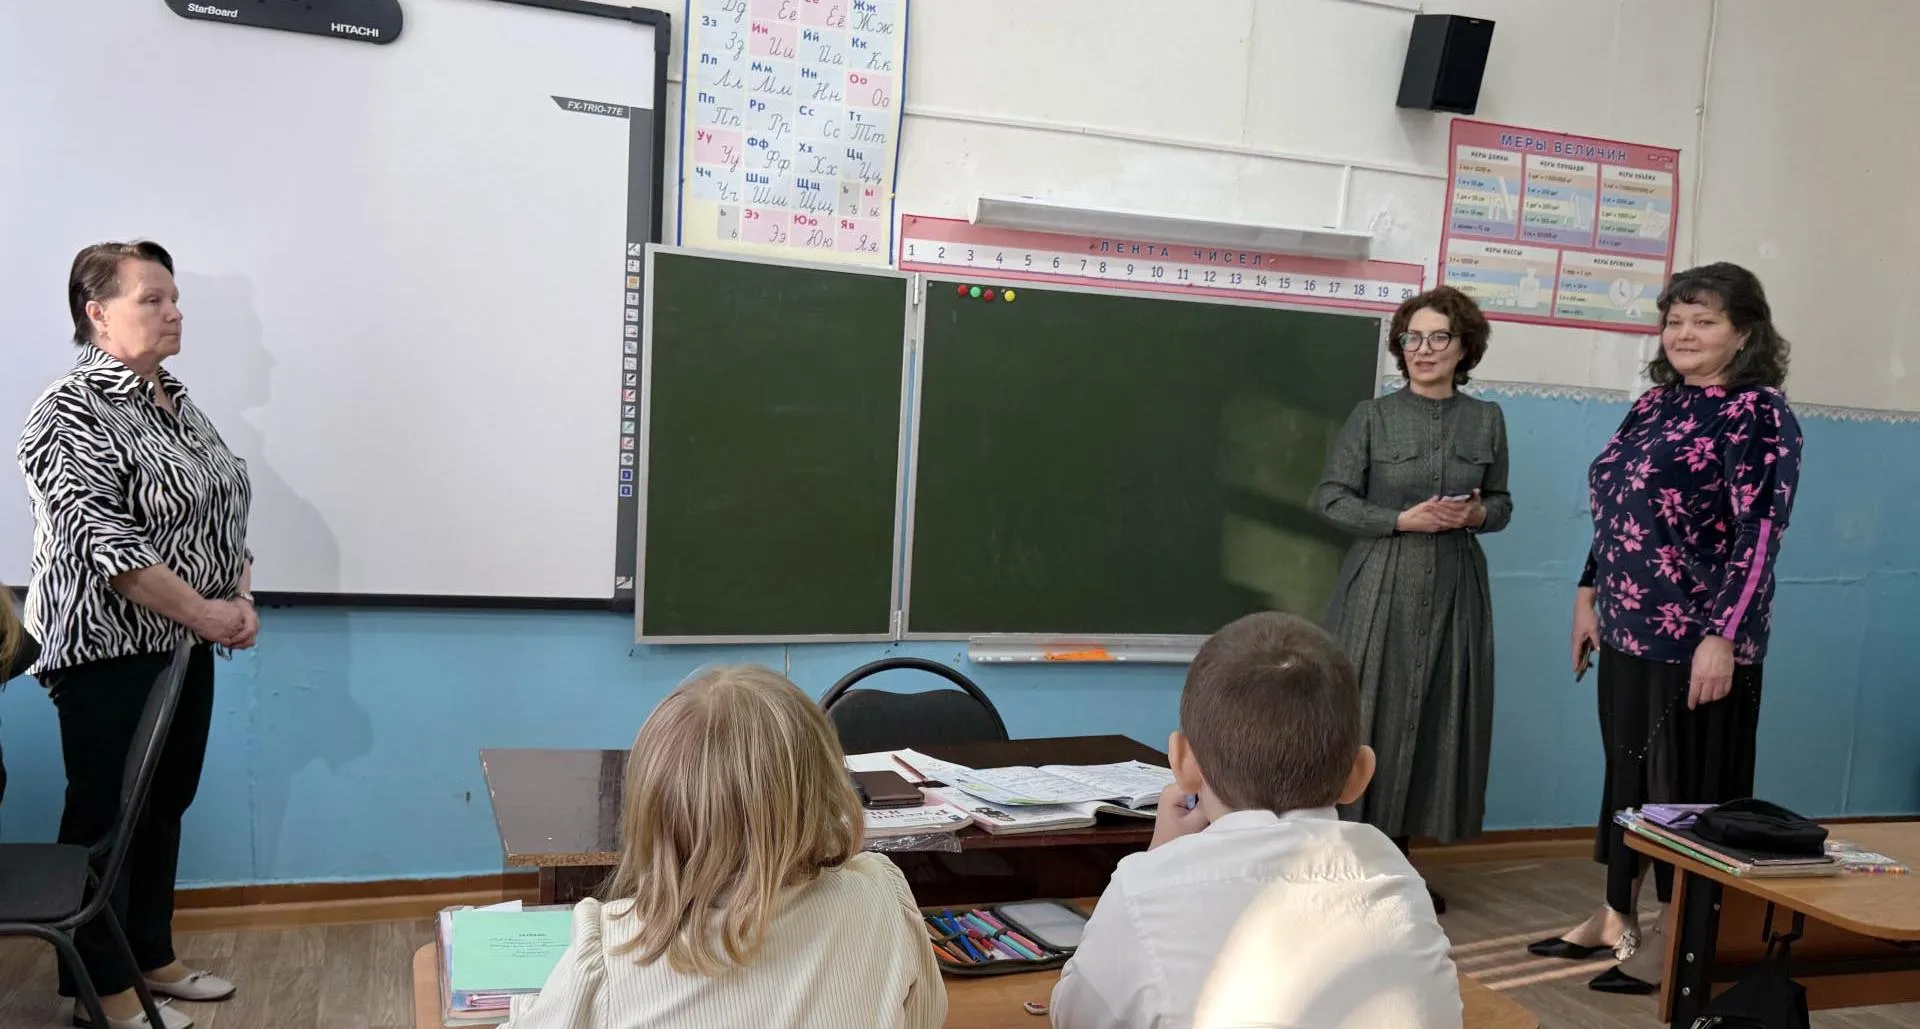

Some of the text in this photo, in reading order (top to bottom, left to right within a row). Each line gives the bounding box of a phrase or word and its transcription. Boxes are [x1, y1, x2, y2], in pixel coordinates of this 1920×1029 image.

[188, 3, 238, 18] StarBoard
[853, 0, 876, 12] Жж
[702, 16, 717, 27] Зз
[752, 23, 768, 34] Ии
[331, 22, 379, 37] HITACHI
[803, 29, 819, 42] Йй
[852, 38, 867, 49] Кк
[701, 53, 718, 65] Лл
[867, 52, 892, 71] Кк
[751, 62, 772, 74] Мм
[801, 68, 817, 80] Нн
[713, 69, 744, 90] Лл
[753, 75, 793, 96] Мм
[849, 74, 868, 85] Оо
[698, 92, 715, 104] Пп
[813, 82, 841, 101] Нн
[871, 88, 890, 108] Оо
[567, 101, 624, 116] FX-TRIO-77E
[750, 99, 766, 112] Рр
[799, 106, 815, 117] Сс
[712, 106, 741, 127] Пп
[849, 111, 862, 122] Тт
[768, 113, 791, 139] Рр
[823, 120, 840, 138] Сс
[697, 130, 712, 143] Уу
[850, 123, 887, 144] Тт
[747, 137, 769, 150] Фф
[799, 142, 813, 153] Хх
[1501, 134, 1628, 161] МЕРЫ ВЕЛИЧИН
[721, 145, 740, 173] Уу
[847, 148, 863, 161] Цц
[763, 150, 791, 177] Фф
[810, 155, 838, 176] Хх
[696, 167, 711, 179] Чч
[746, 173, 769, 185] Шш
[718, 181, 739, 201] Чч
[797, 178, 821, 192] Щщ
[752, 185, 788, 207] Шш
[744, 209, 759, 220] Ээ
[794, 215, 818, 227] Юю
[841, 220, 855, 230] Яя
[769, 224, 786, 242] Ээ
[806, 229, 833, 248] Юю
[856, 234, 879, 253] Яя
[1100, 241, 1262, 265] ЛЕНТА ЧИСЕЛ
[908, 244, 1413, 299] 1 2 3 4 5 6 7 8 9 10 11 12 13 14 15 16 17 18 19 20
